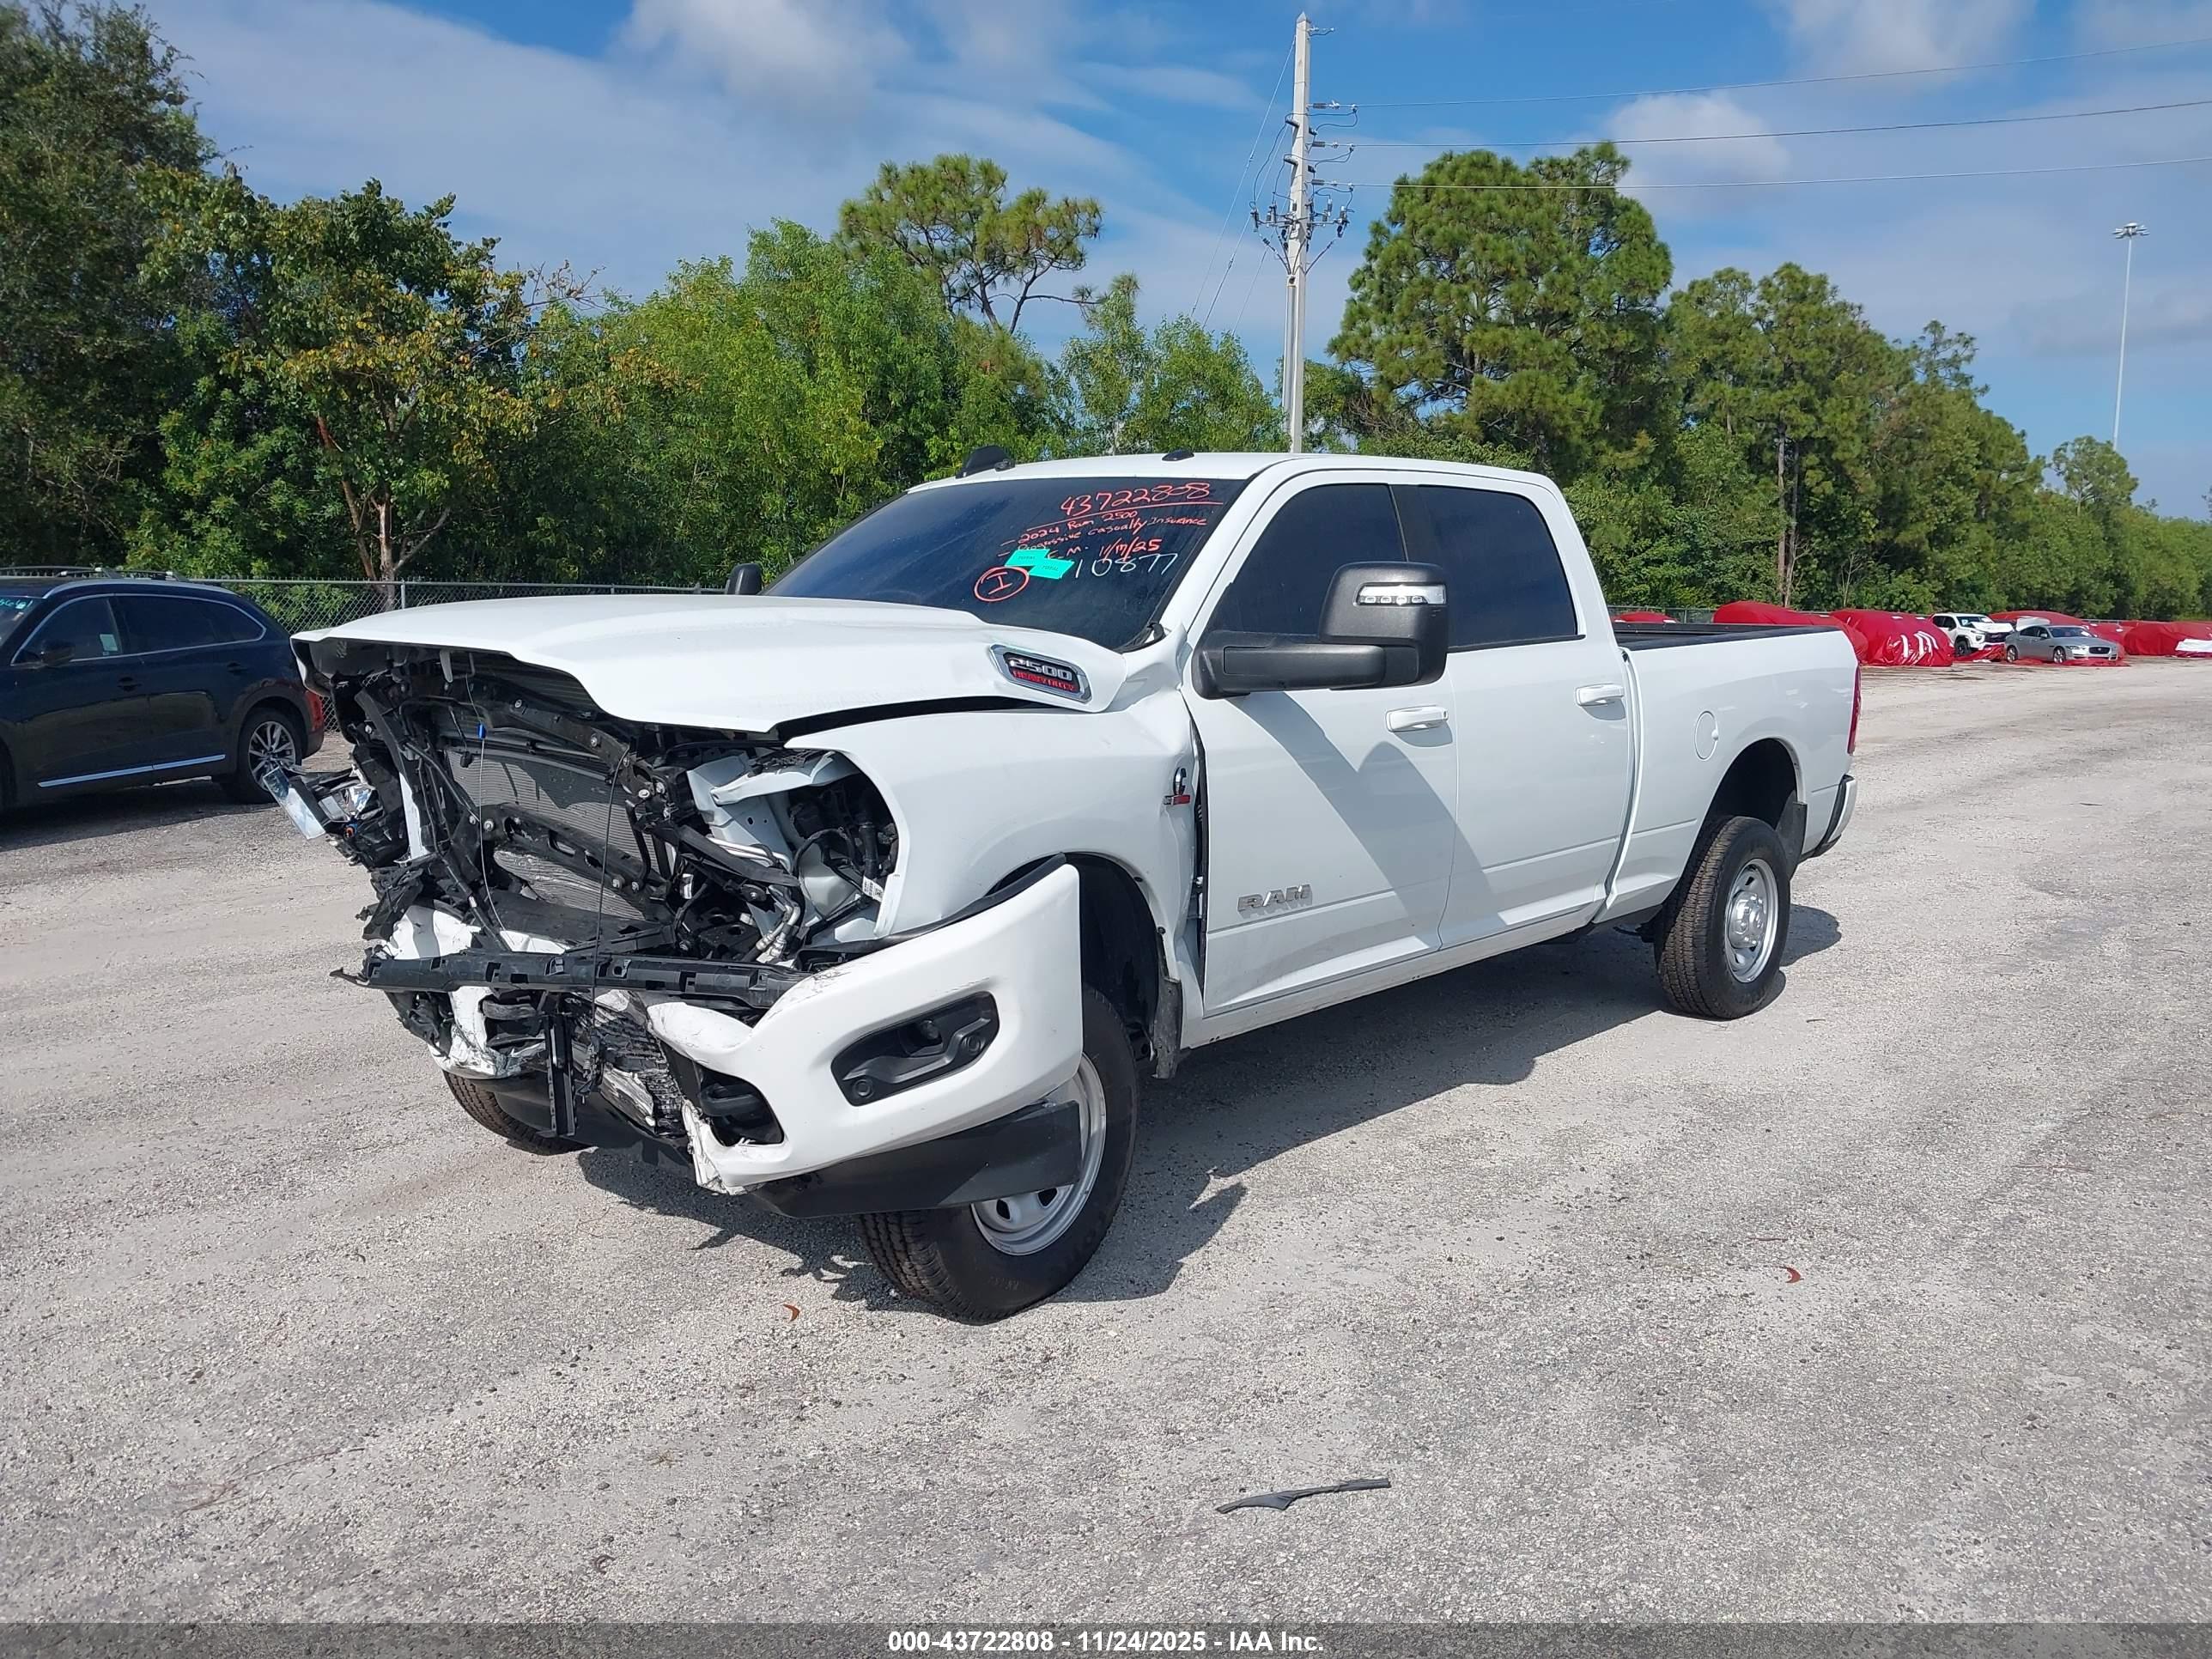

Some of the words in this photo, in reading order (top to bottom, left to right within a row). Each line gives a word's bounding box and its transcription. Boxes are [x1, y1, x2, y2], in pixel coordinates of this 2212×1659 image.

[1060, 483, 1210, 515] 43722808
[1018, 526, 1060, 544] 2024
[1101, 511, 1138, 522] 2500
[1075, 553, 1178, 578] 10877
[1008, 657, 1073, 681] 2500
[1237, 884, 1311, 912] RAM
